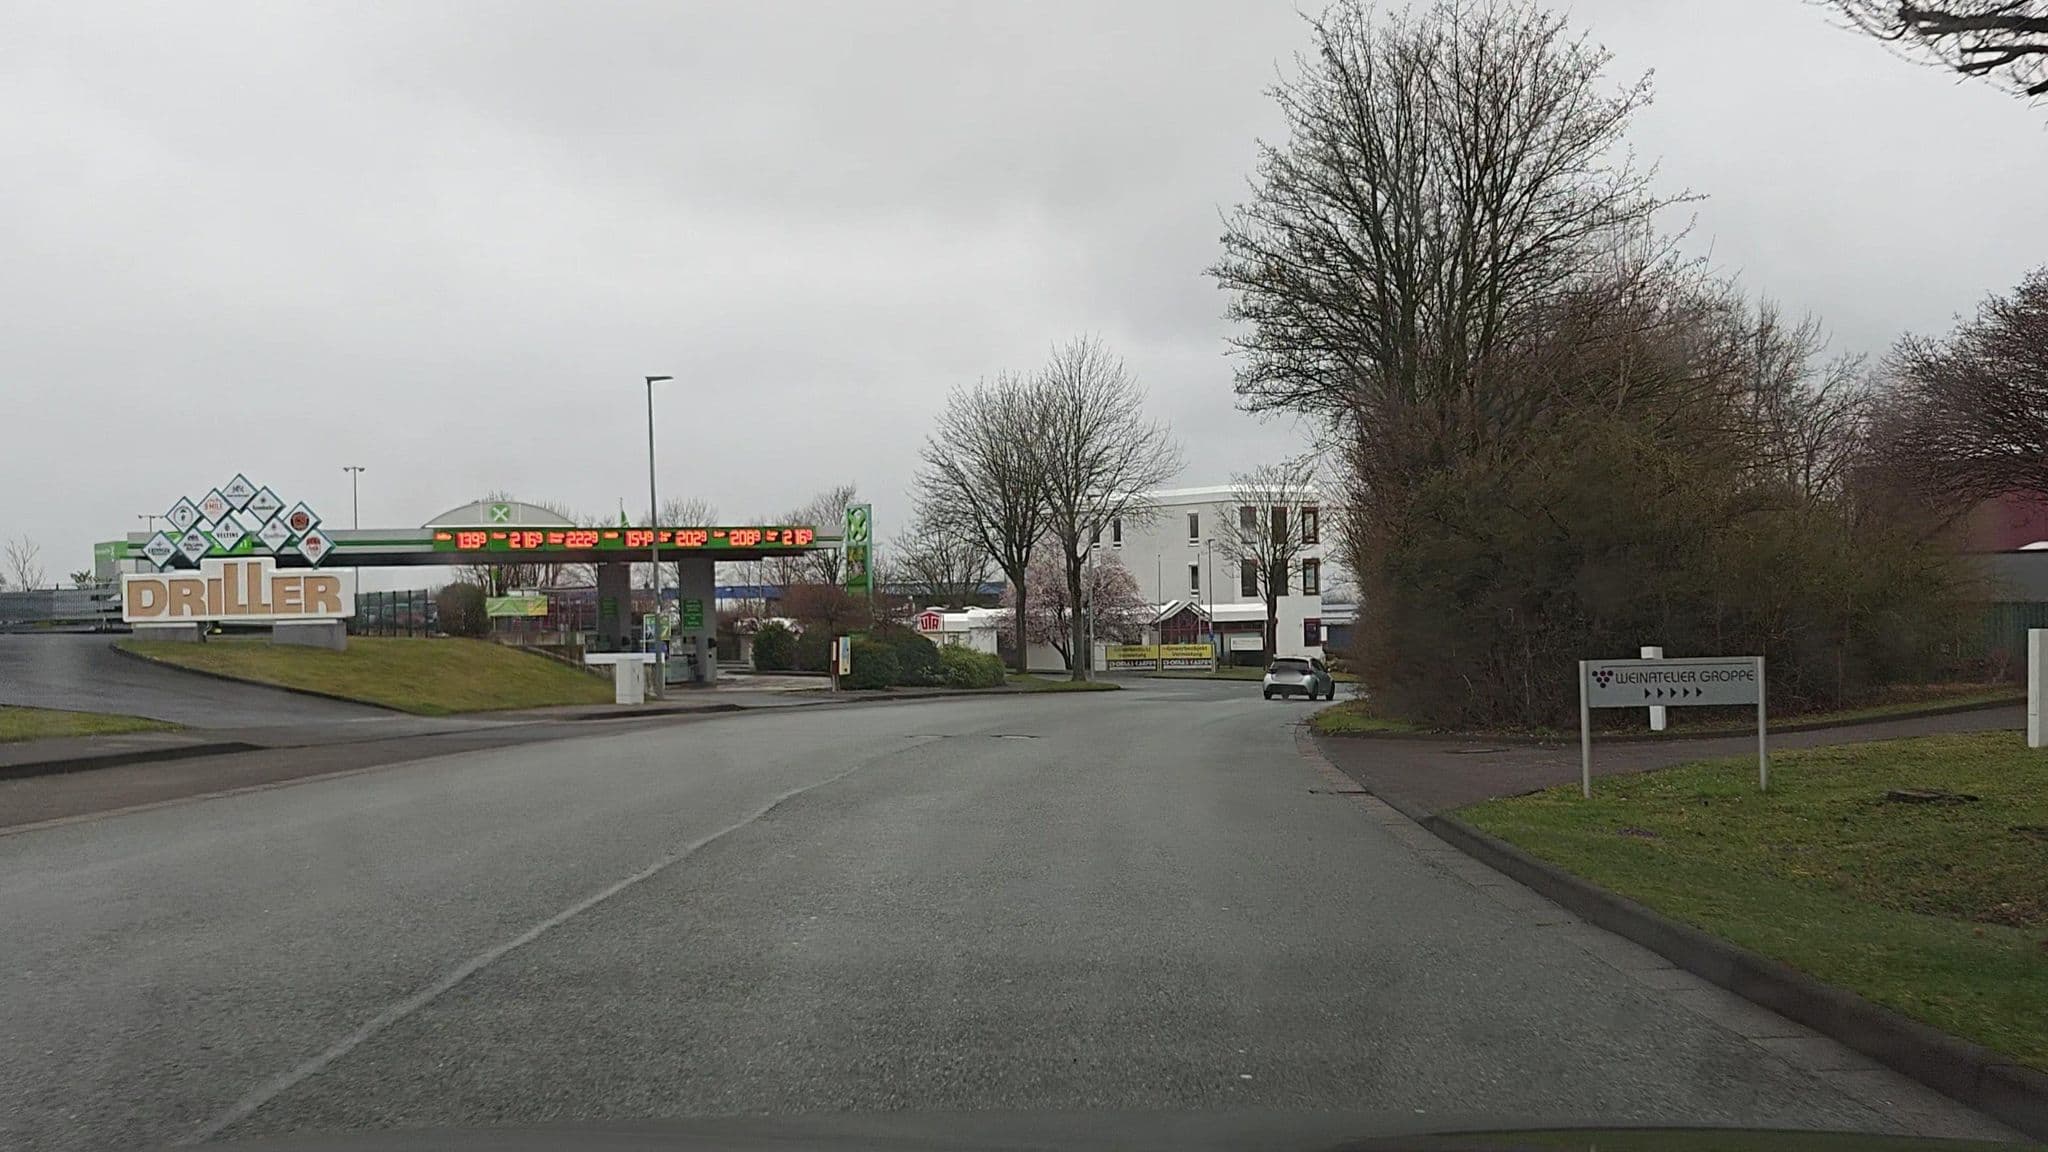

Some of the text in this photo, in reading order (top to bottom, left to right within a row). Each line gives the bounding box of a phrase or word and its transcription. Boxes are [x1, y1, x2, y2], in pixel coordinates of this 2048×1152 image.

[128, 562, 342, 617] DRILLER
[920, 613, 939, 629] UTA
[1615, 670, 1754, 685] WEINATELIER GROPPE
